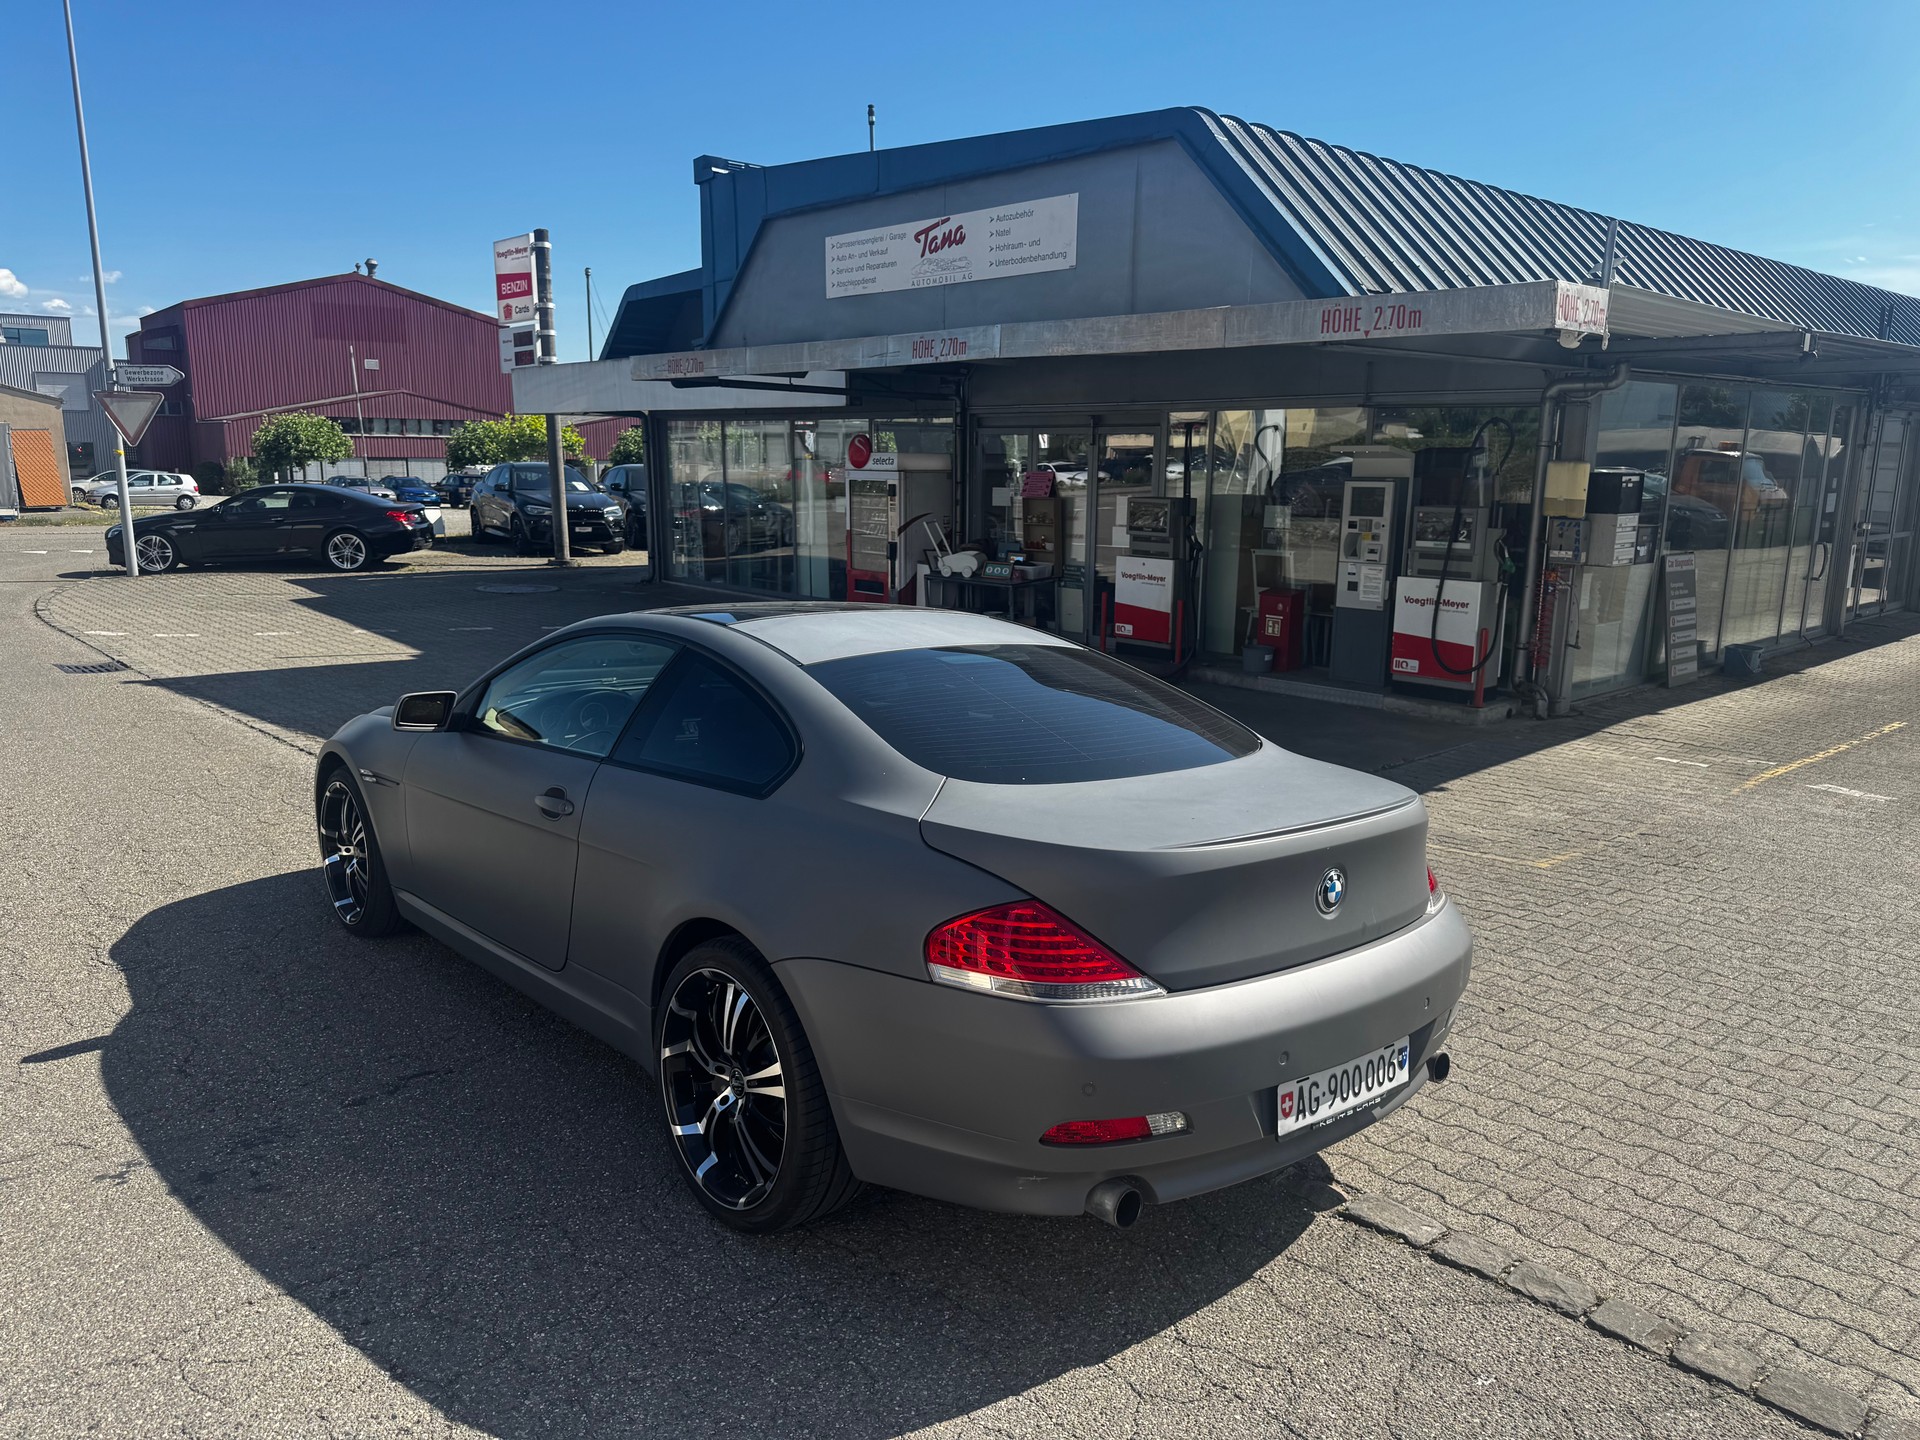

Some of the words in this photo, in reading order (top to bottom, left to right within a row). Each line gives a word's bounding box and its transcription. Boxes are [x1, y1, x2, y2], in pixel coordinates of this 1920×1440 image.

[995, 209, 1034, 222] Autozubehör
[914, 216, 966, 258] Tana
[995, 227, 1011, 237] Natel
[836, 235, 885, 250] Carrosseriespenglerei
[889, 232, 907, 241] Garage
[995, 241, 1027, 252] Hohlraum-
[1028, 237, 1041, 247] und
[858, 250, 868, 258] und
[869, 247, 888, 257] Verkauf
[995, 251, 1067, 267] Unterbodenbehandlung
[836, 267, 854, 275] Service
[855, 264, 865, 272] und
[866, 261, 897, 271] Reparaturen
[836, 277, 877, 288] Abschleppdienst
[911, 275, 956, 287] AUTOMOBIL
[962, 272, 973, 280] AG
[501, 279, 528, 295] BENZIN
[514, 305, 530, 314] Cards
[1558, 289, 1580, 323] HÖHE
[1321, 304, 1362, 334] HÖHE
[912, 336, 935, 359] HÖHE
[872, 457, 895, 465] selecta
[1458, 530, 1467, 541] 2
[1121, 571, 1166, 583] Voegtlin-Meyer
